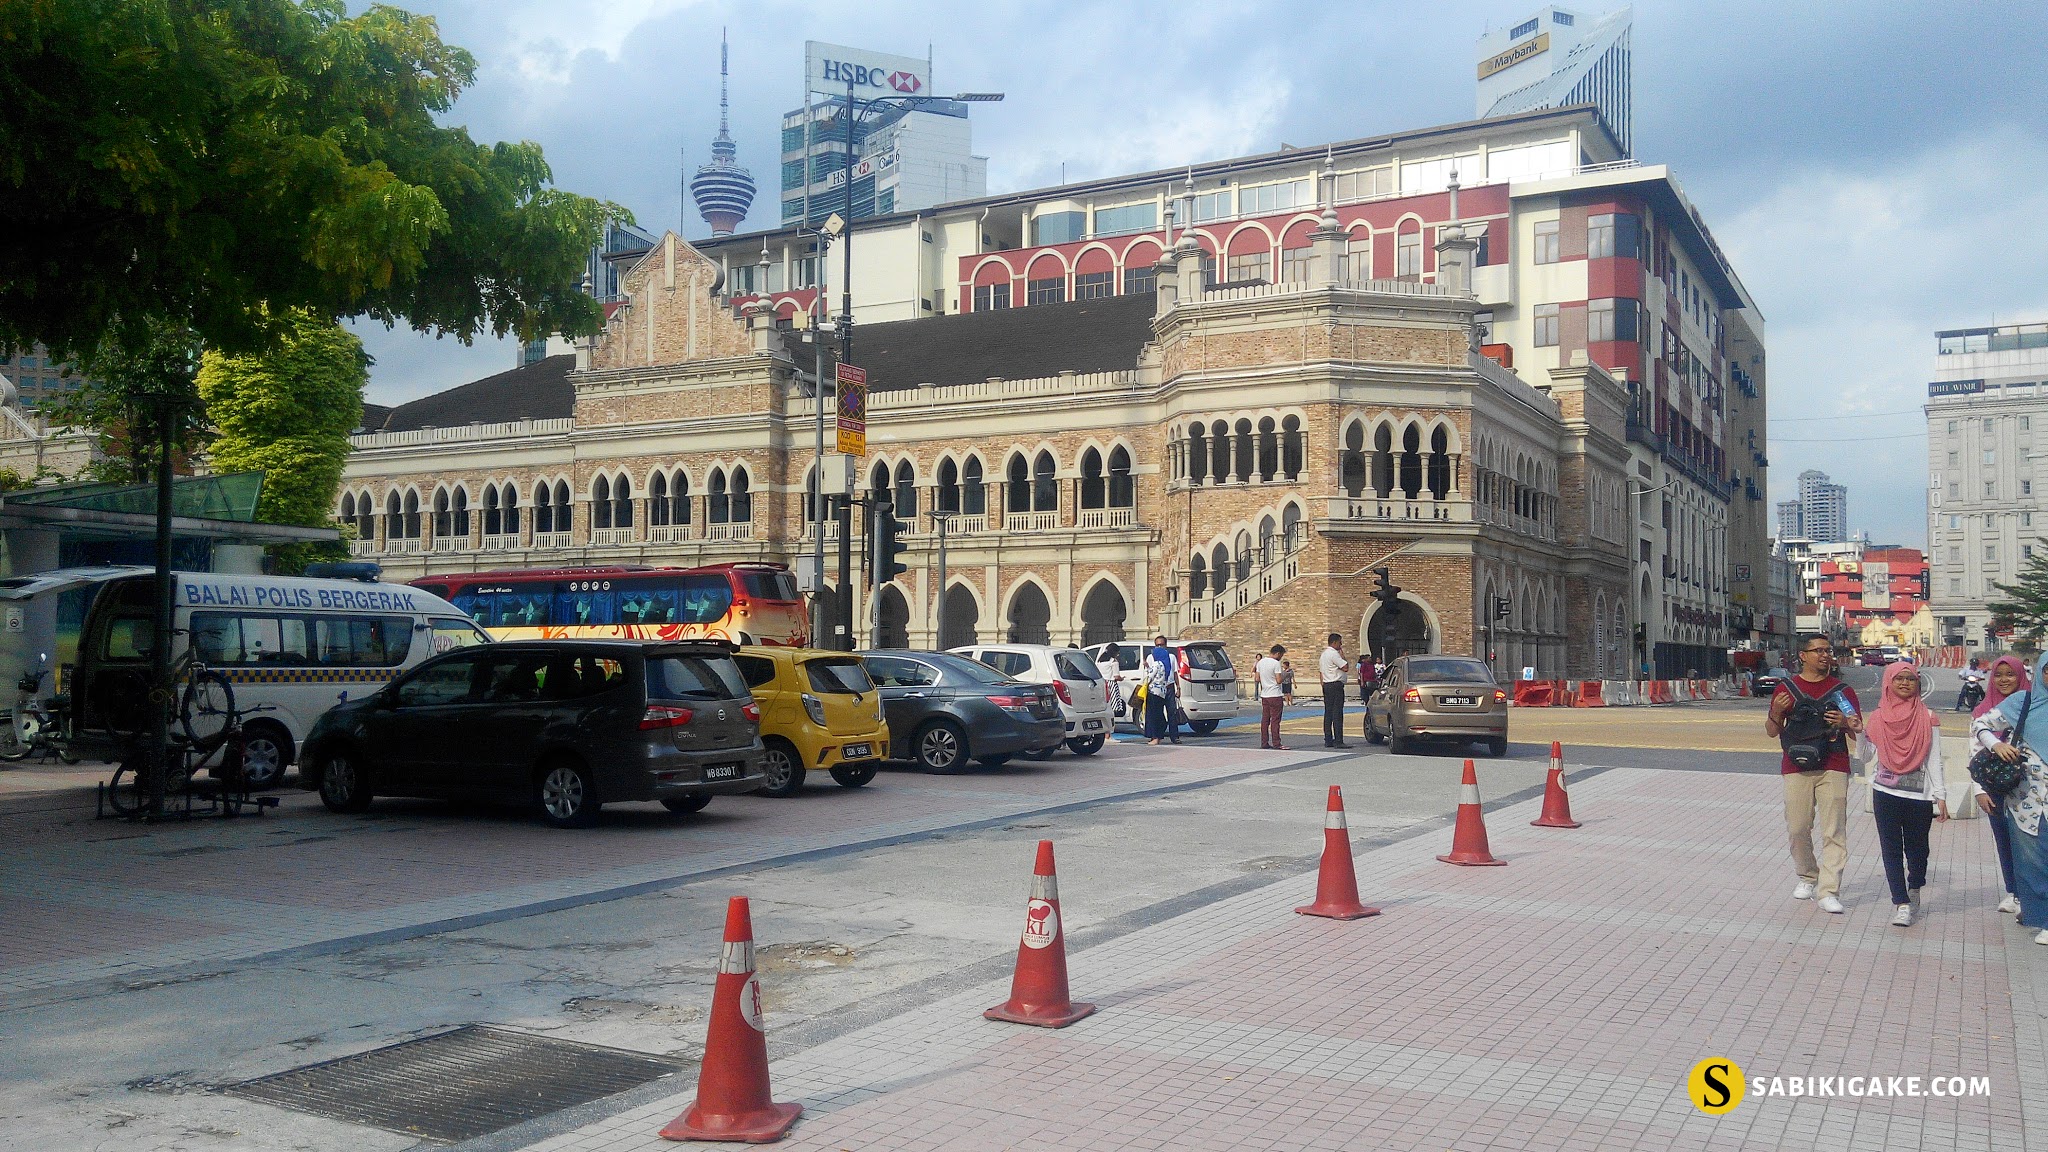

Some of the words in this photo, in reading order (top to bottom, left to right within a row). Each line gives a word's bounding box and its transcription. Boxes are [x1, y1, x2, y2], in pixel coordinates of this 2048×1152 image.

[1494, 42, 1538, 68] Maybank
[823, 59, 885, 88] HSBC
[833, 167, 857, 185] HSC
[1930, 472, 1943, 565] HOTEL
[185, 584, 248, 605] BALAI
[254, 586, 313, 607] POLIS
[318, 589, 417, 611] BERGERAK
[715, 767, 731, 777] 8330
[1025, 919, 1050, 936] KL
